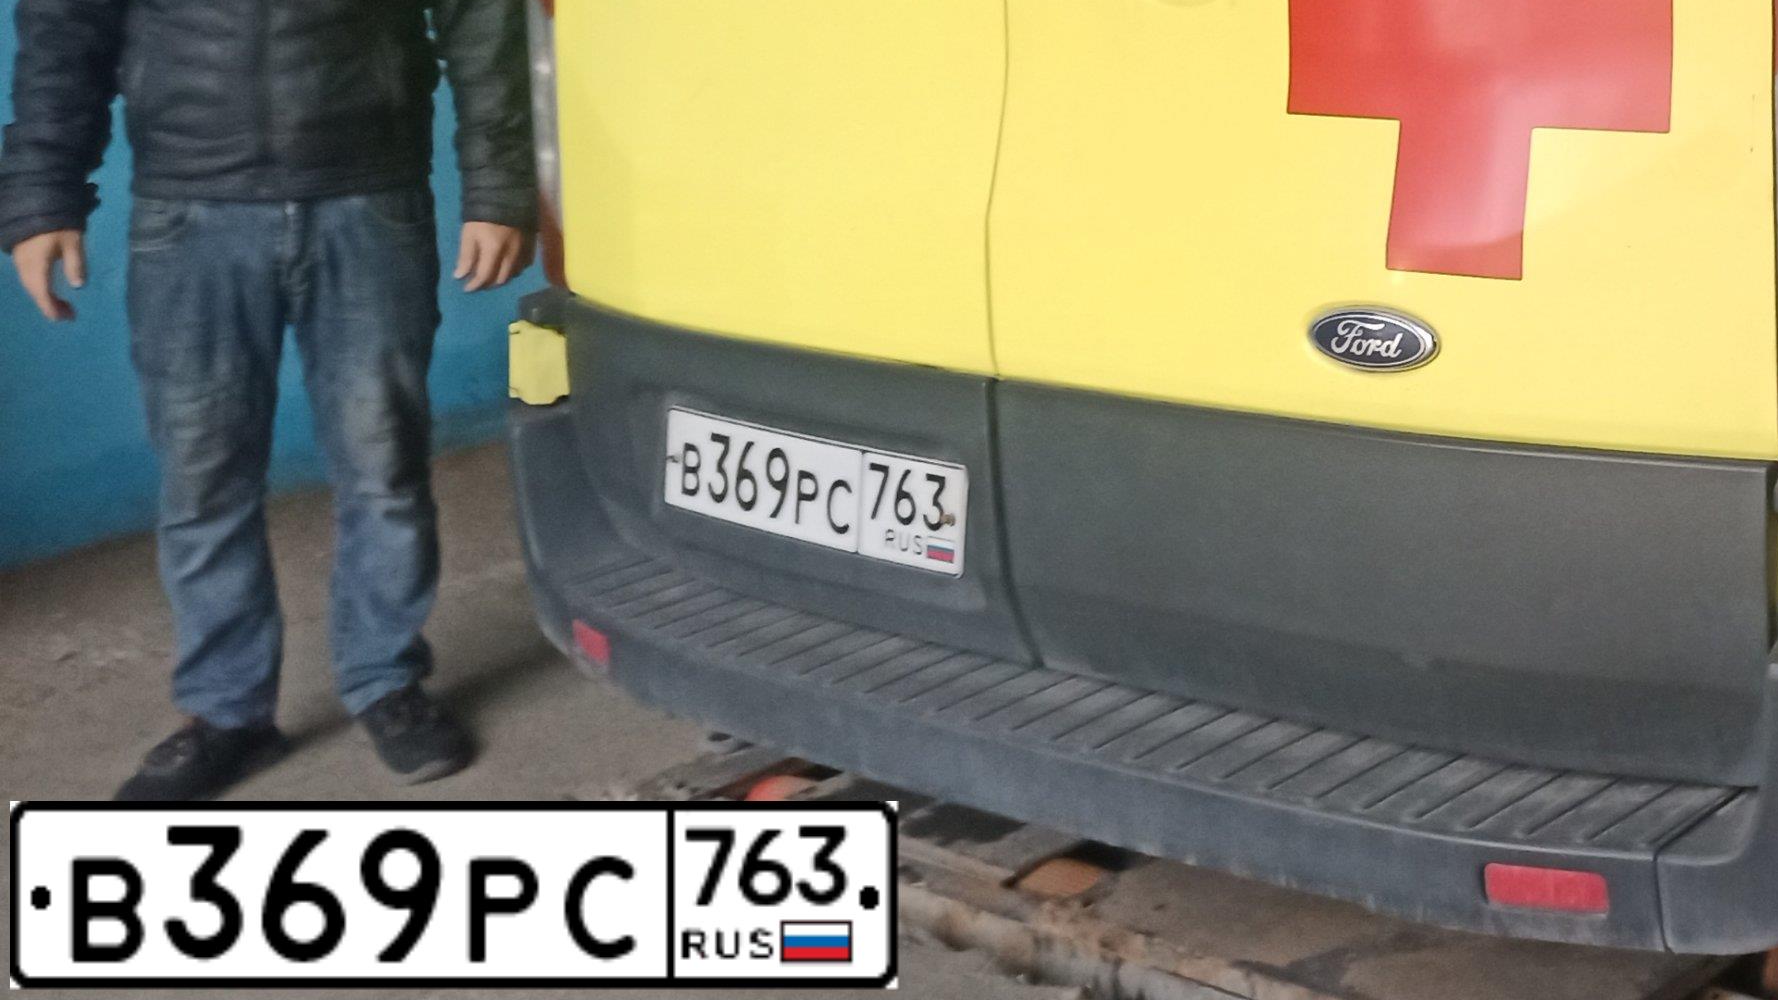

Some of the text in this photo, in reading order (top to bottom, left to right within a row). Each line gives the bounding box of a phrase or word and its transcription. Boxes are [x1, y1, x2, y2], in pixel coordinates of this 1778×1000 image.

[1331, 320, 1403, 358] Ford
[869, 463, 945, 531] 763
[885, 529, 922, 555] RUS
